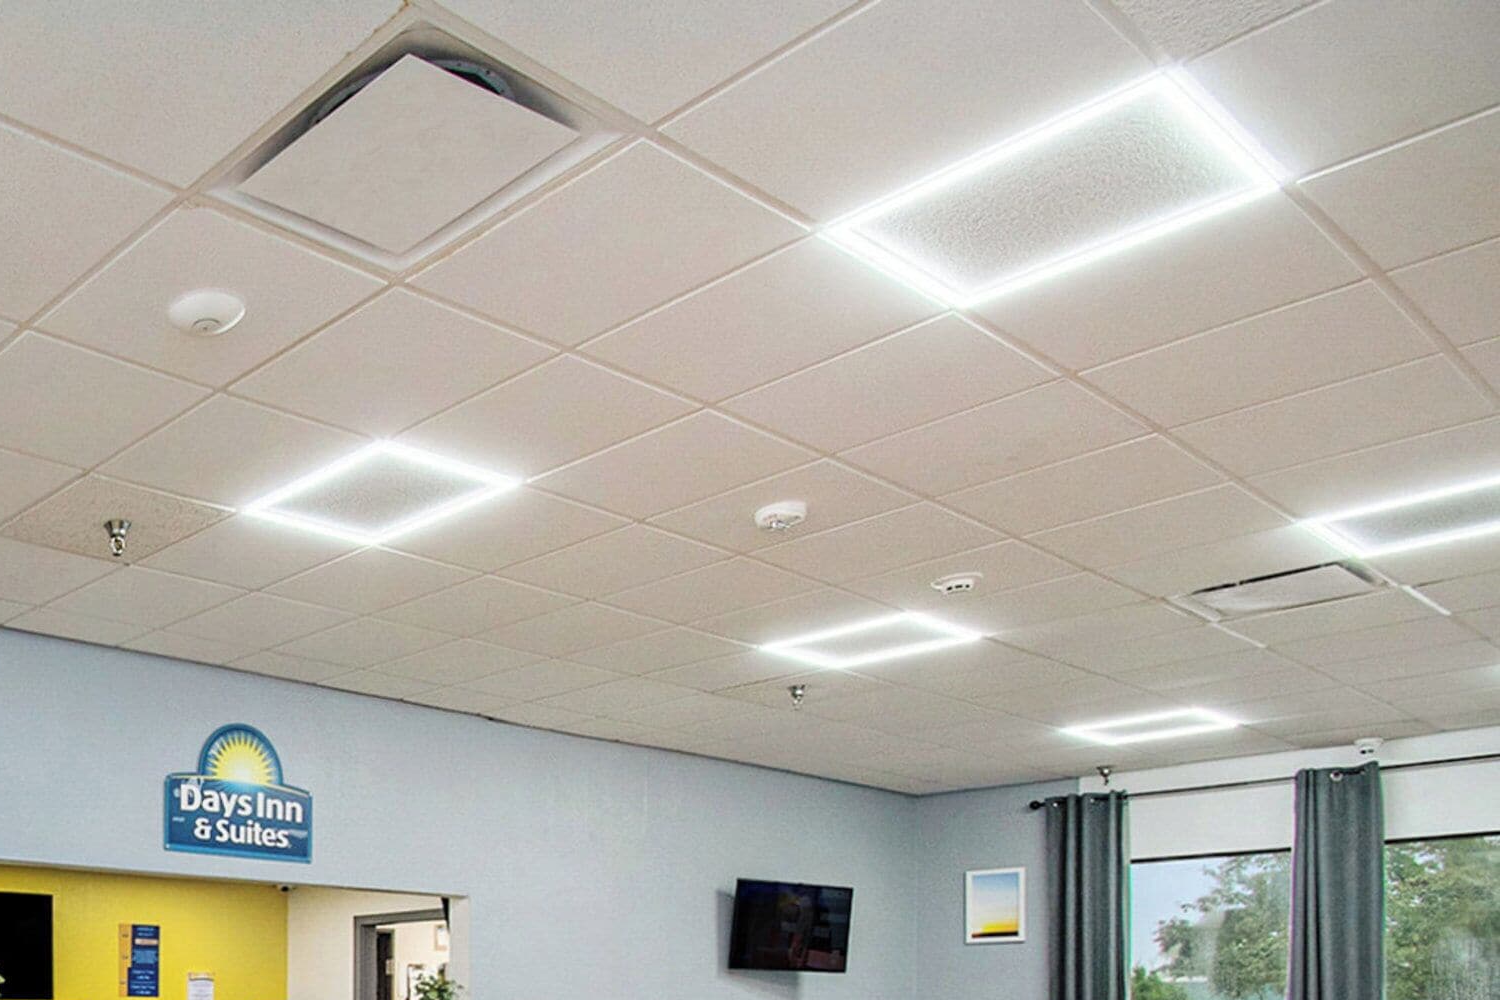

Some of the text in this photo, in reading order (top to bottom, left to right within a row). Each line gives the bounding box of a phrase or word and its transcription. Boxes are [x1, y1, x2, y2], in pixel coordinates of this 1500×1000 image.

[180, 783, 304, 823] Days Inn
[193, 817, 290, 848] & Suites
